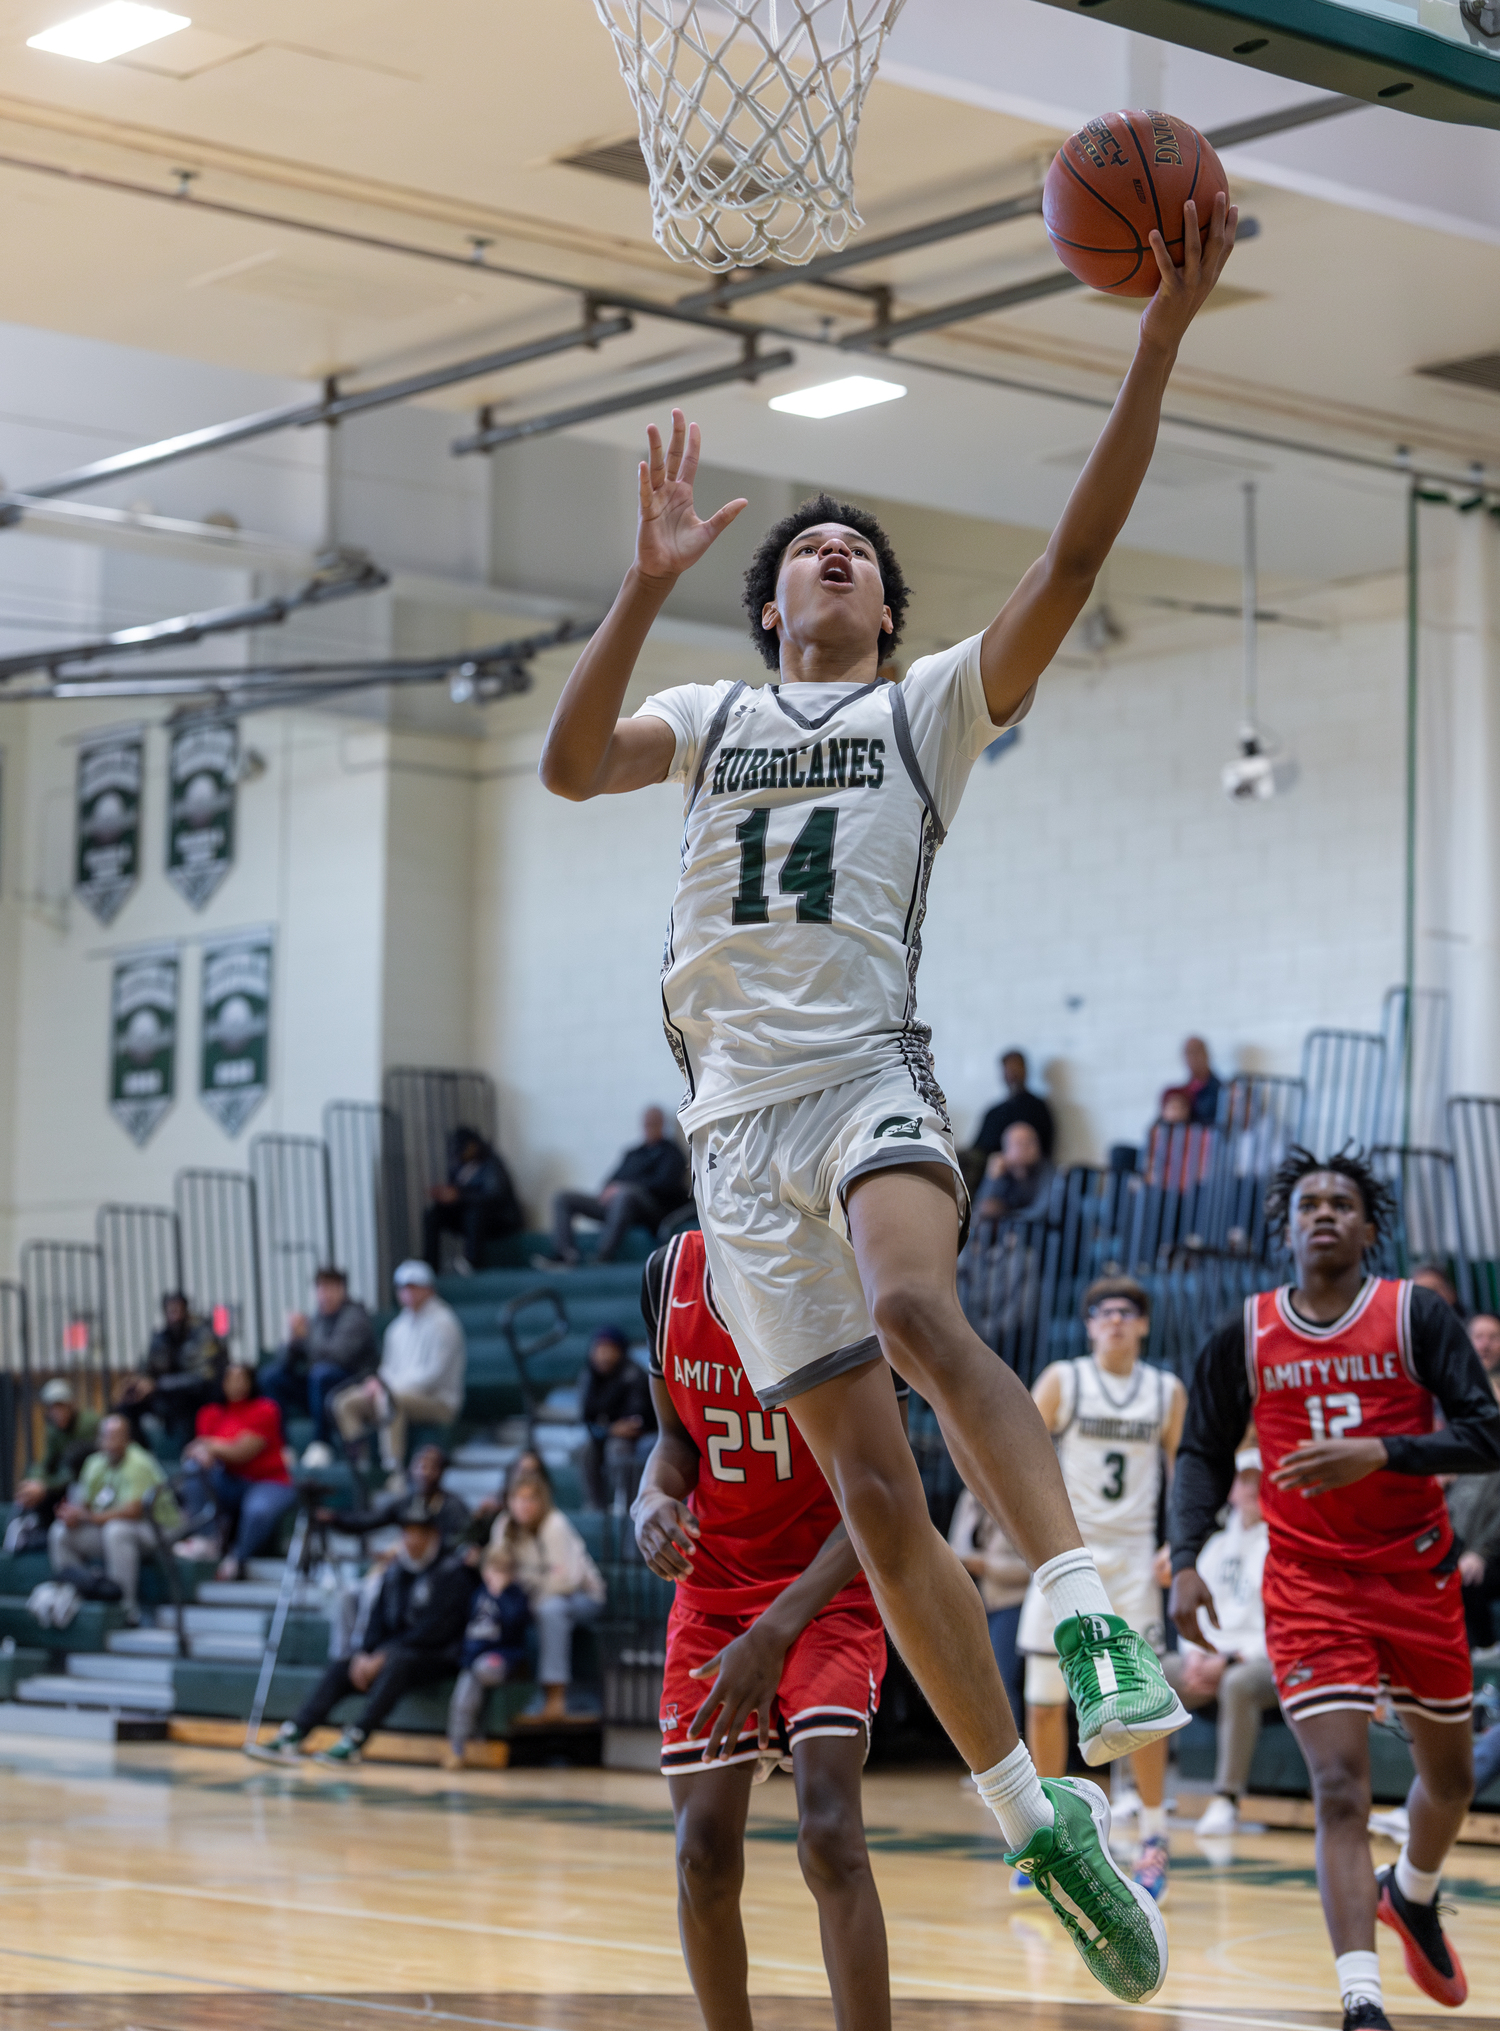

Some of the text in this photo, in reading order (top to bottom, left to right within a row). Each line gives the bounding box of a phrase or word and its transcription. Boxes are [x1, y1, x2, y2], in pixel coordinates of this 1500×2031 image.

[711, 738, 886, 795] HURRICANES
[732, 806, 840, 925] 14
[674, 1355, 745, 1397] AMITY
[1263, 1352, 1398, 1392] AMITYVILLE
[1304, 1391, 1363, 1440] 12
[703, 1405, 793, 1484] 24
[1102, 1451, 1126, 1501] 3
